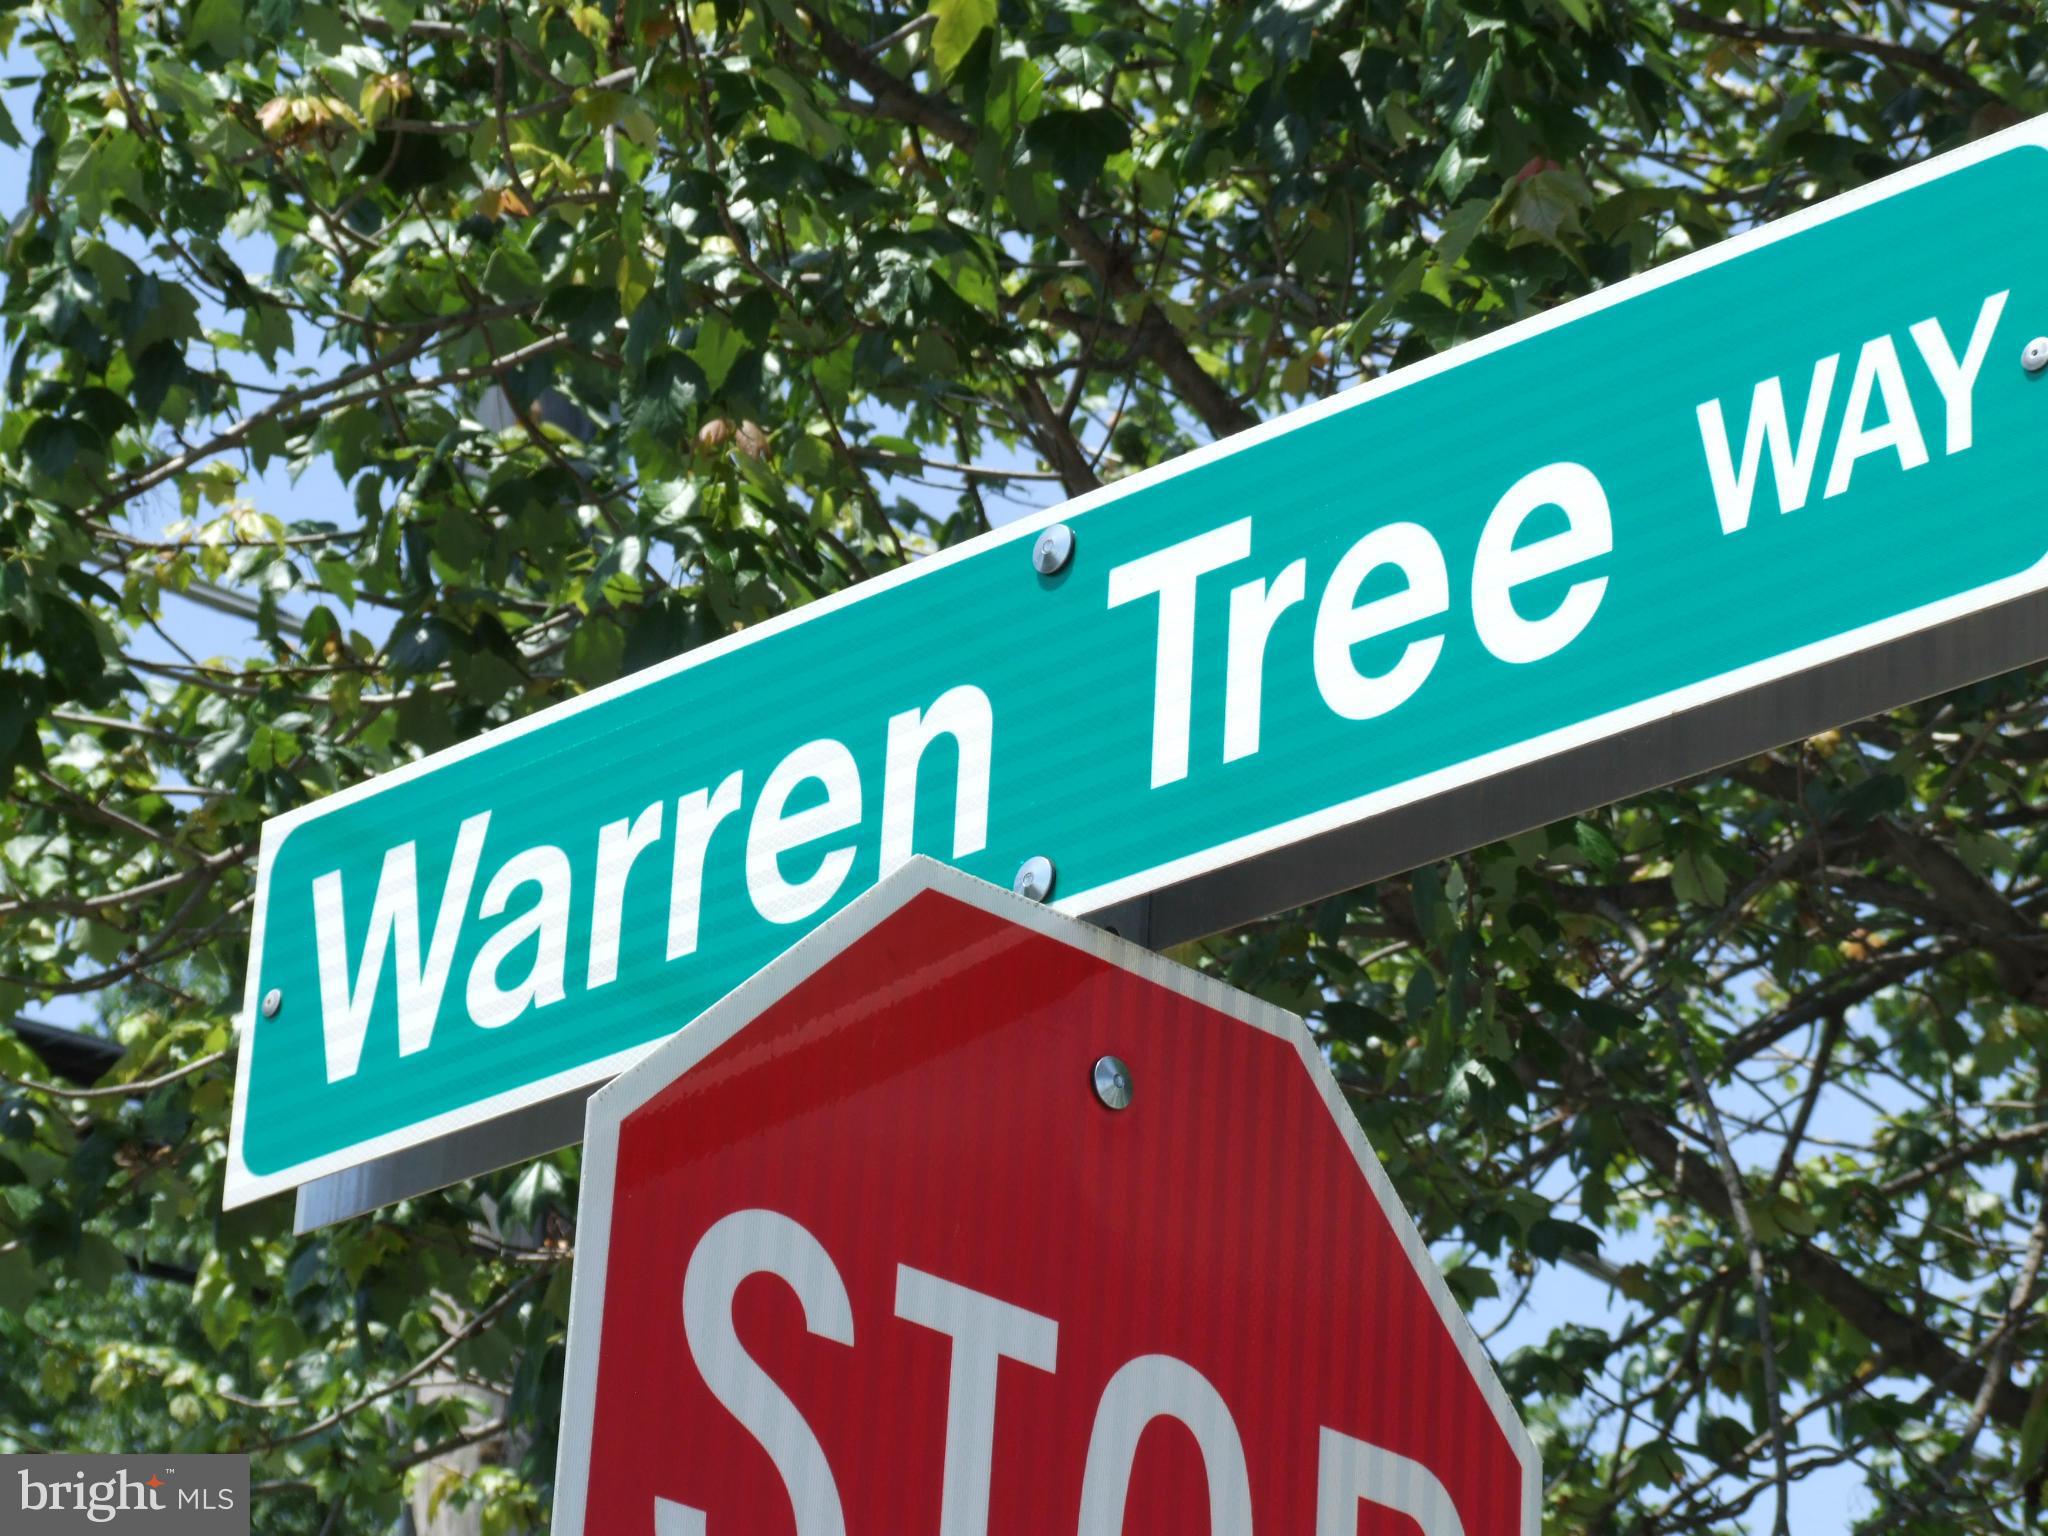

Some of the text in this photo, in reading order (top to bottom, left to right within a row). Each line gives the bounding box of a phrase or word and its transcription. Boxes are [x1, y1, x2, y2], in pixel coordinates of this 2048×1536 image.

[312, 288, 2011, 1084] Warren Tree WAY
[653, 1207, 1467, 1536] ST
